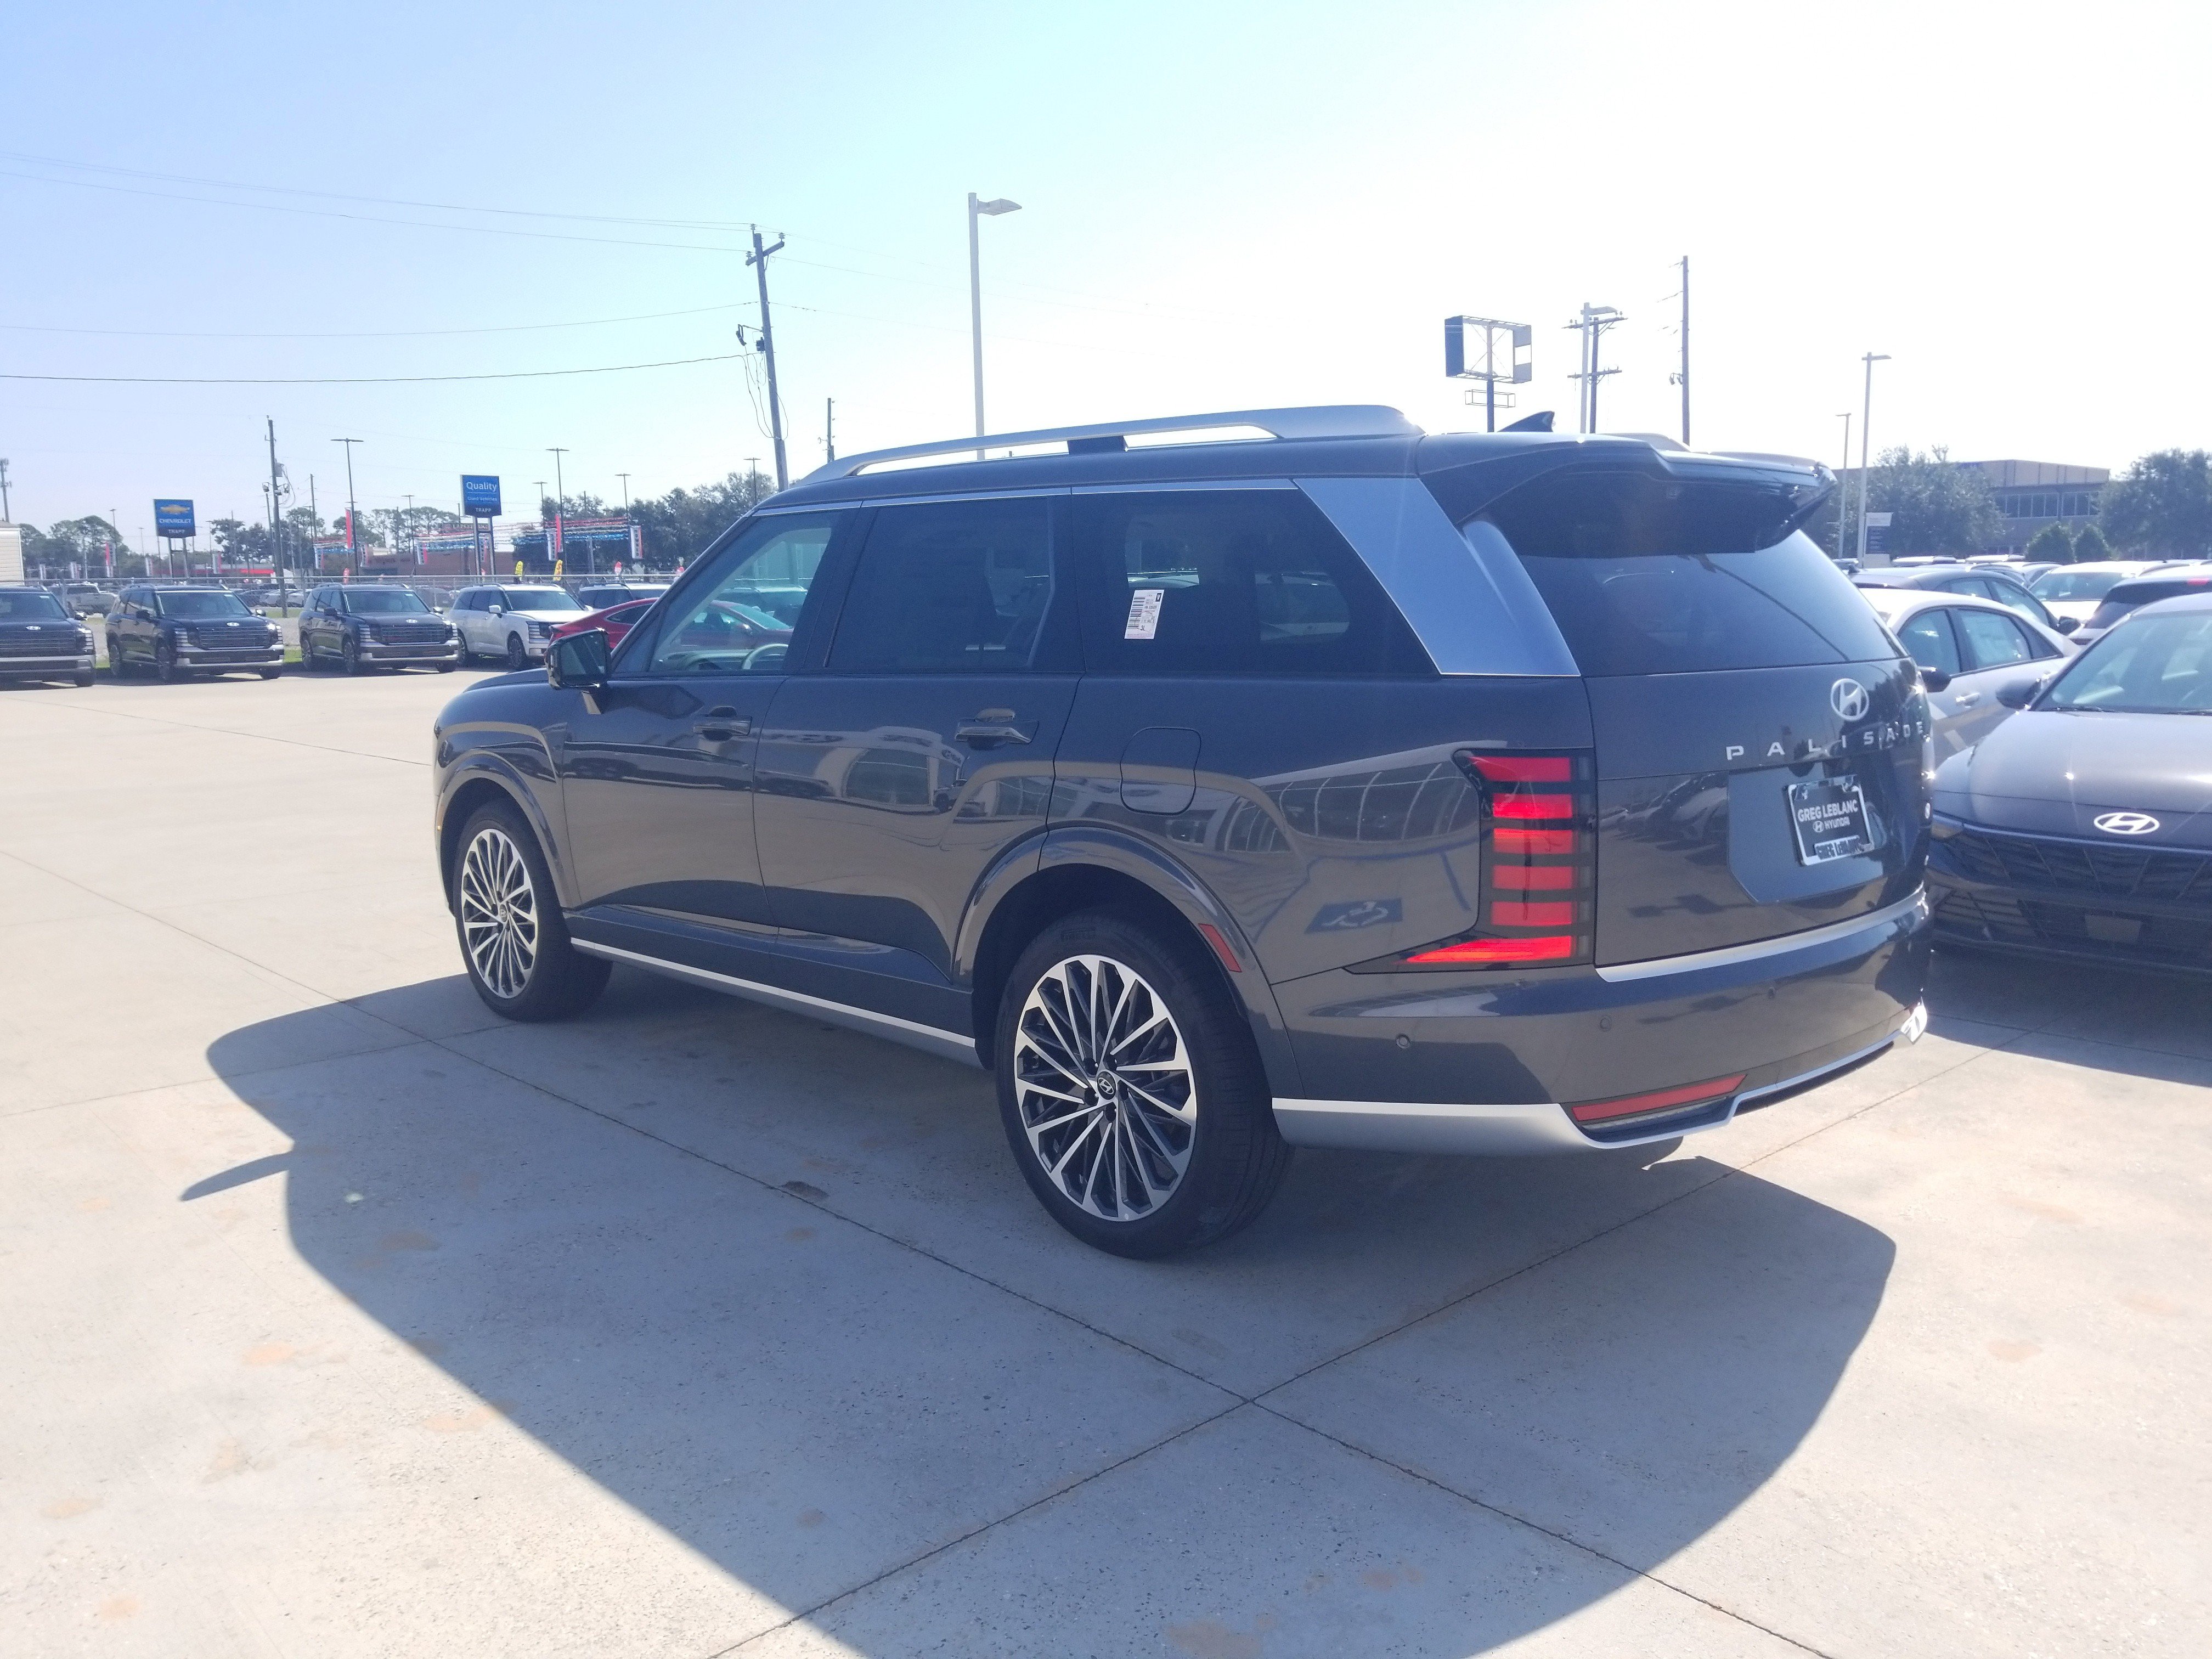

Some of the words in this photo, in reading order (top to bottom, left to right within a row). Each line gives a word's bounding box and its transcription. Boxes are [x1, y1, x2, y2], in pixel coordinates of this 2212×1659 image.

[466, 482, 496, 492] Quality
[1726, 721, 1923, 760] PALISADE
[1797, 806, 1822, 822] GREG
[1822, 799, 1858, 818] LEBLANC
[1825, 816, 1850, 830] HYUNDAI
